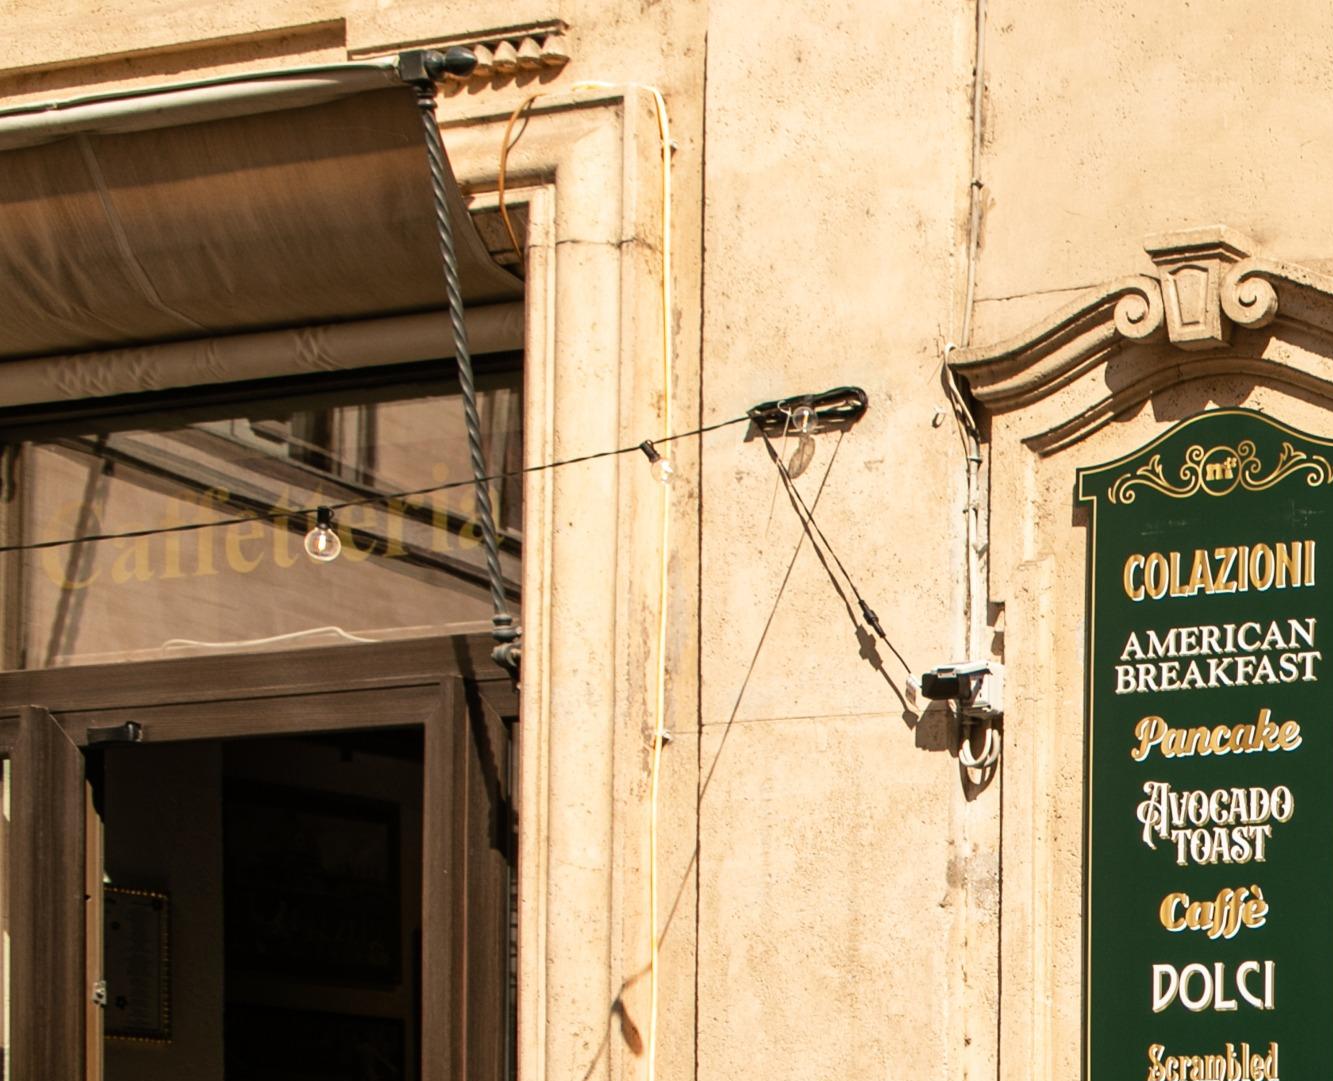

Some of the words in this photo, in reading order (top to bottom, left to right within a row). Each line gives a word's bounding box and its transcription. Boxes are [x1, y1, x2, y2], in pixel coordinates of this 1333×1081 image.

[1123, 540, 1316, 601] COLAZIONI
[1119, 618, 1318, 661] AMERICAN
[1114, 651, 1322, 695] BREAKFAST
[1131, 708, 1303, 762] Pancake
[1136, 781, 1295, 849] AVOCADO
[1171, 825, 1273, 866] TOAST
[1159, 884, 1269, 939] Caffè
[1151, 960, 1276, 1013] DOLCI
